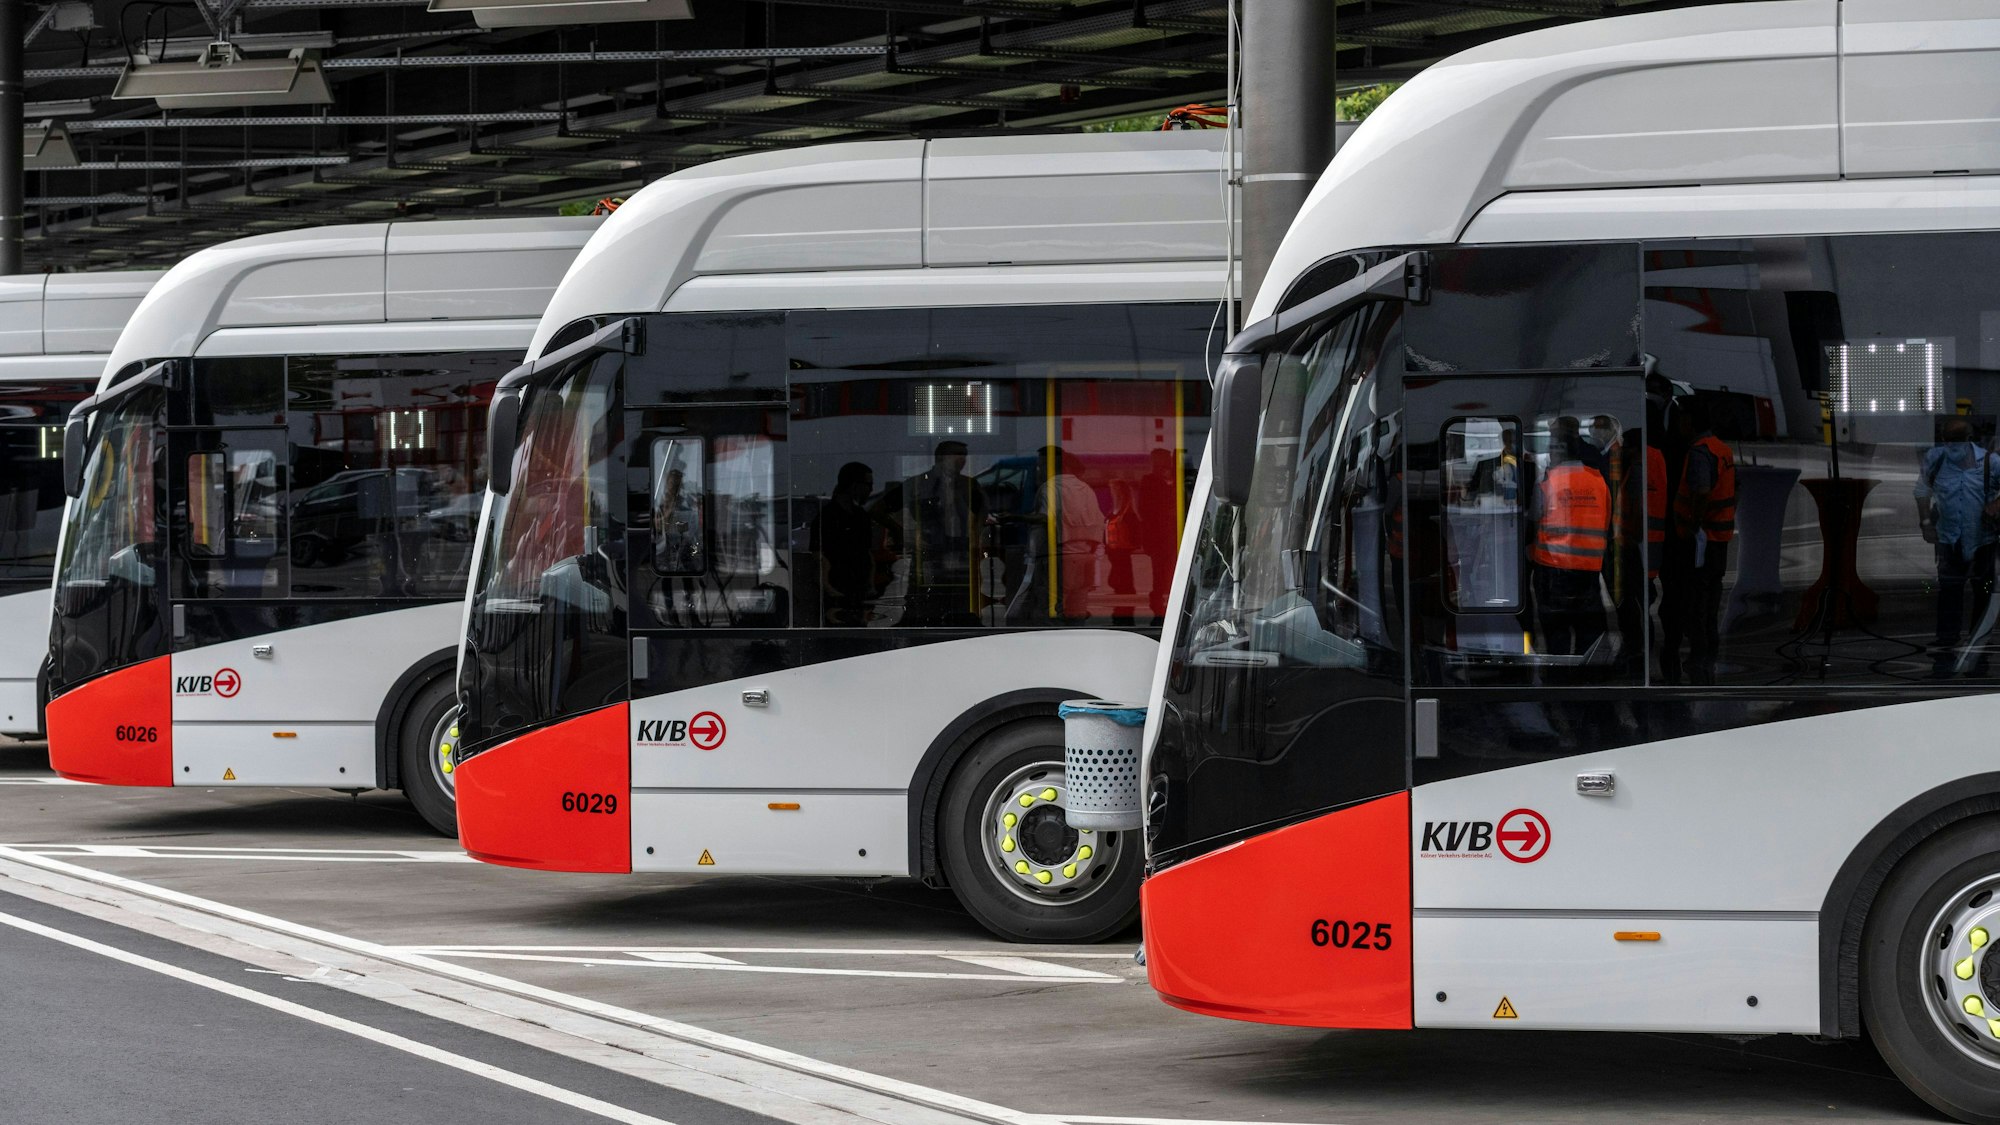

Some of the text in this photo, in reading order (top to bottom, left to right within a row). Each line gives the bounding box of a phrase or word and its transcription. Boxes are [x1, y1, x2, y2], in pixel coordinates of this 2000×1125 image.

[176, 676, 212, 693] KVB
[116, 725, 158, 743] 6026
[637, 720, 687, 741] KVB
[562, 791, 618, 815] 6029
[1421, 821, 1494, 851] KVB
[1311, 919, 1392, 951] 6025
